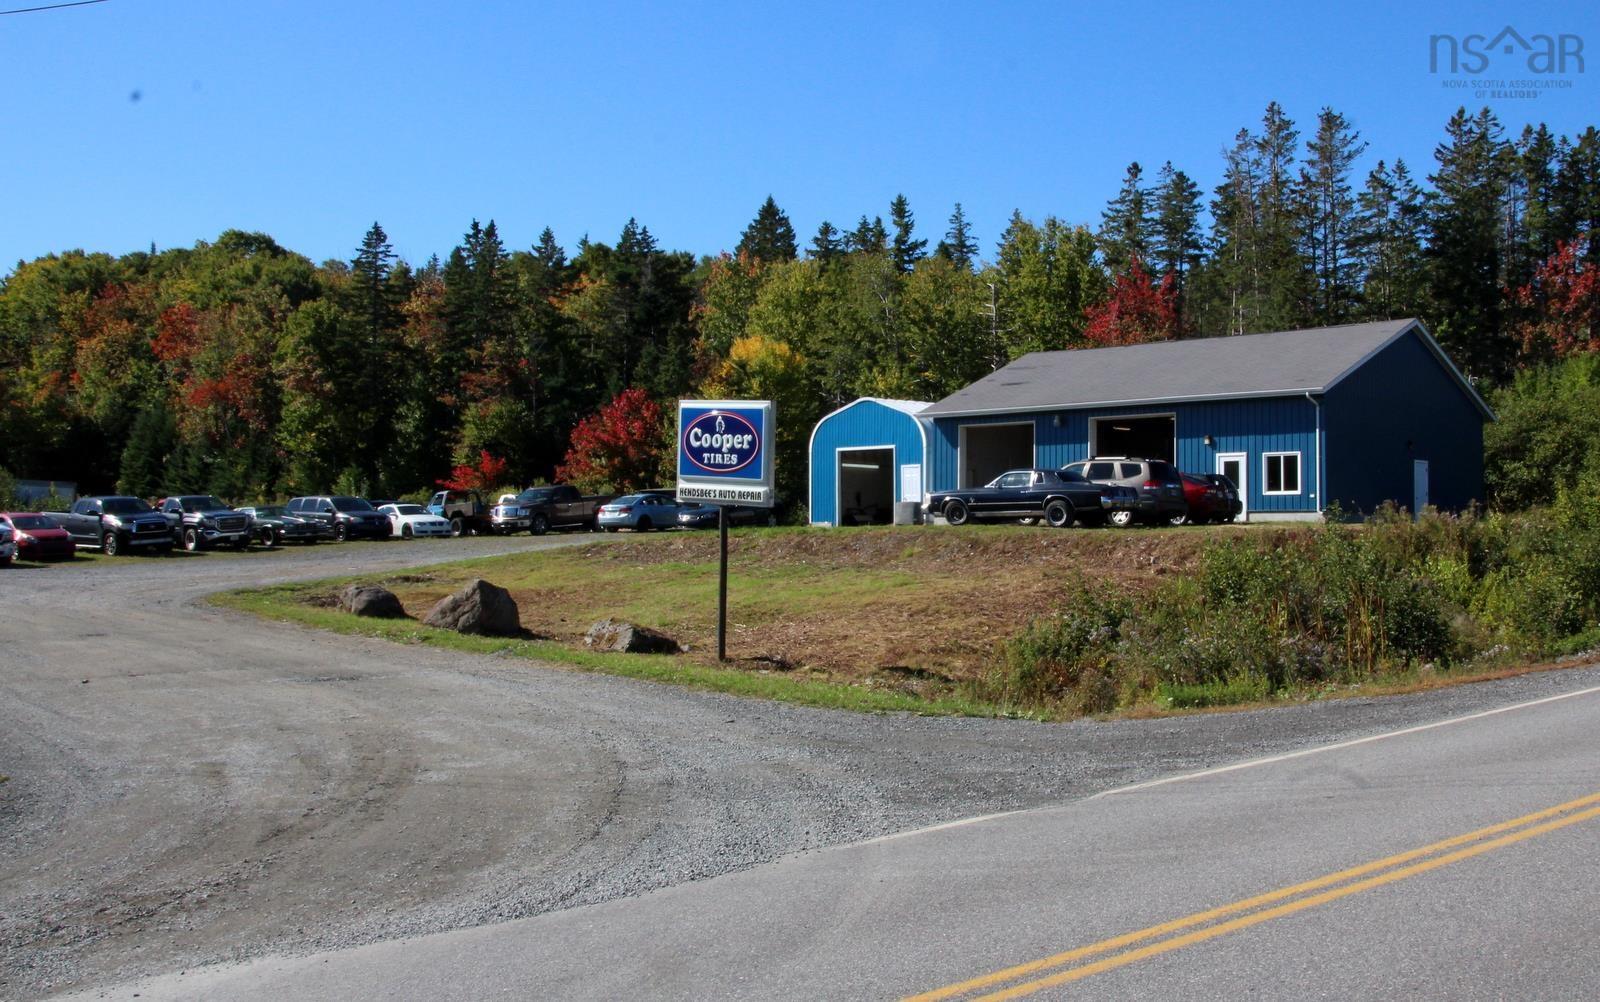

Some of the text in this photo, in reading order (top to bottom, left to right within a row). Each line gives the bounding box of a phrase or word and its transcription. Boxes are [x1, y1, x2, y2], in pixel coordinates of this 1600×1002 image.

[689, 427, 753, 453] Cooper
[702, 453, 738, 465] TIRES
[680, 488, 762, 501] HENDSBEE'S AUTO REPAIR
